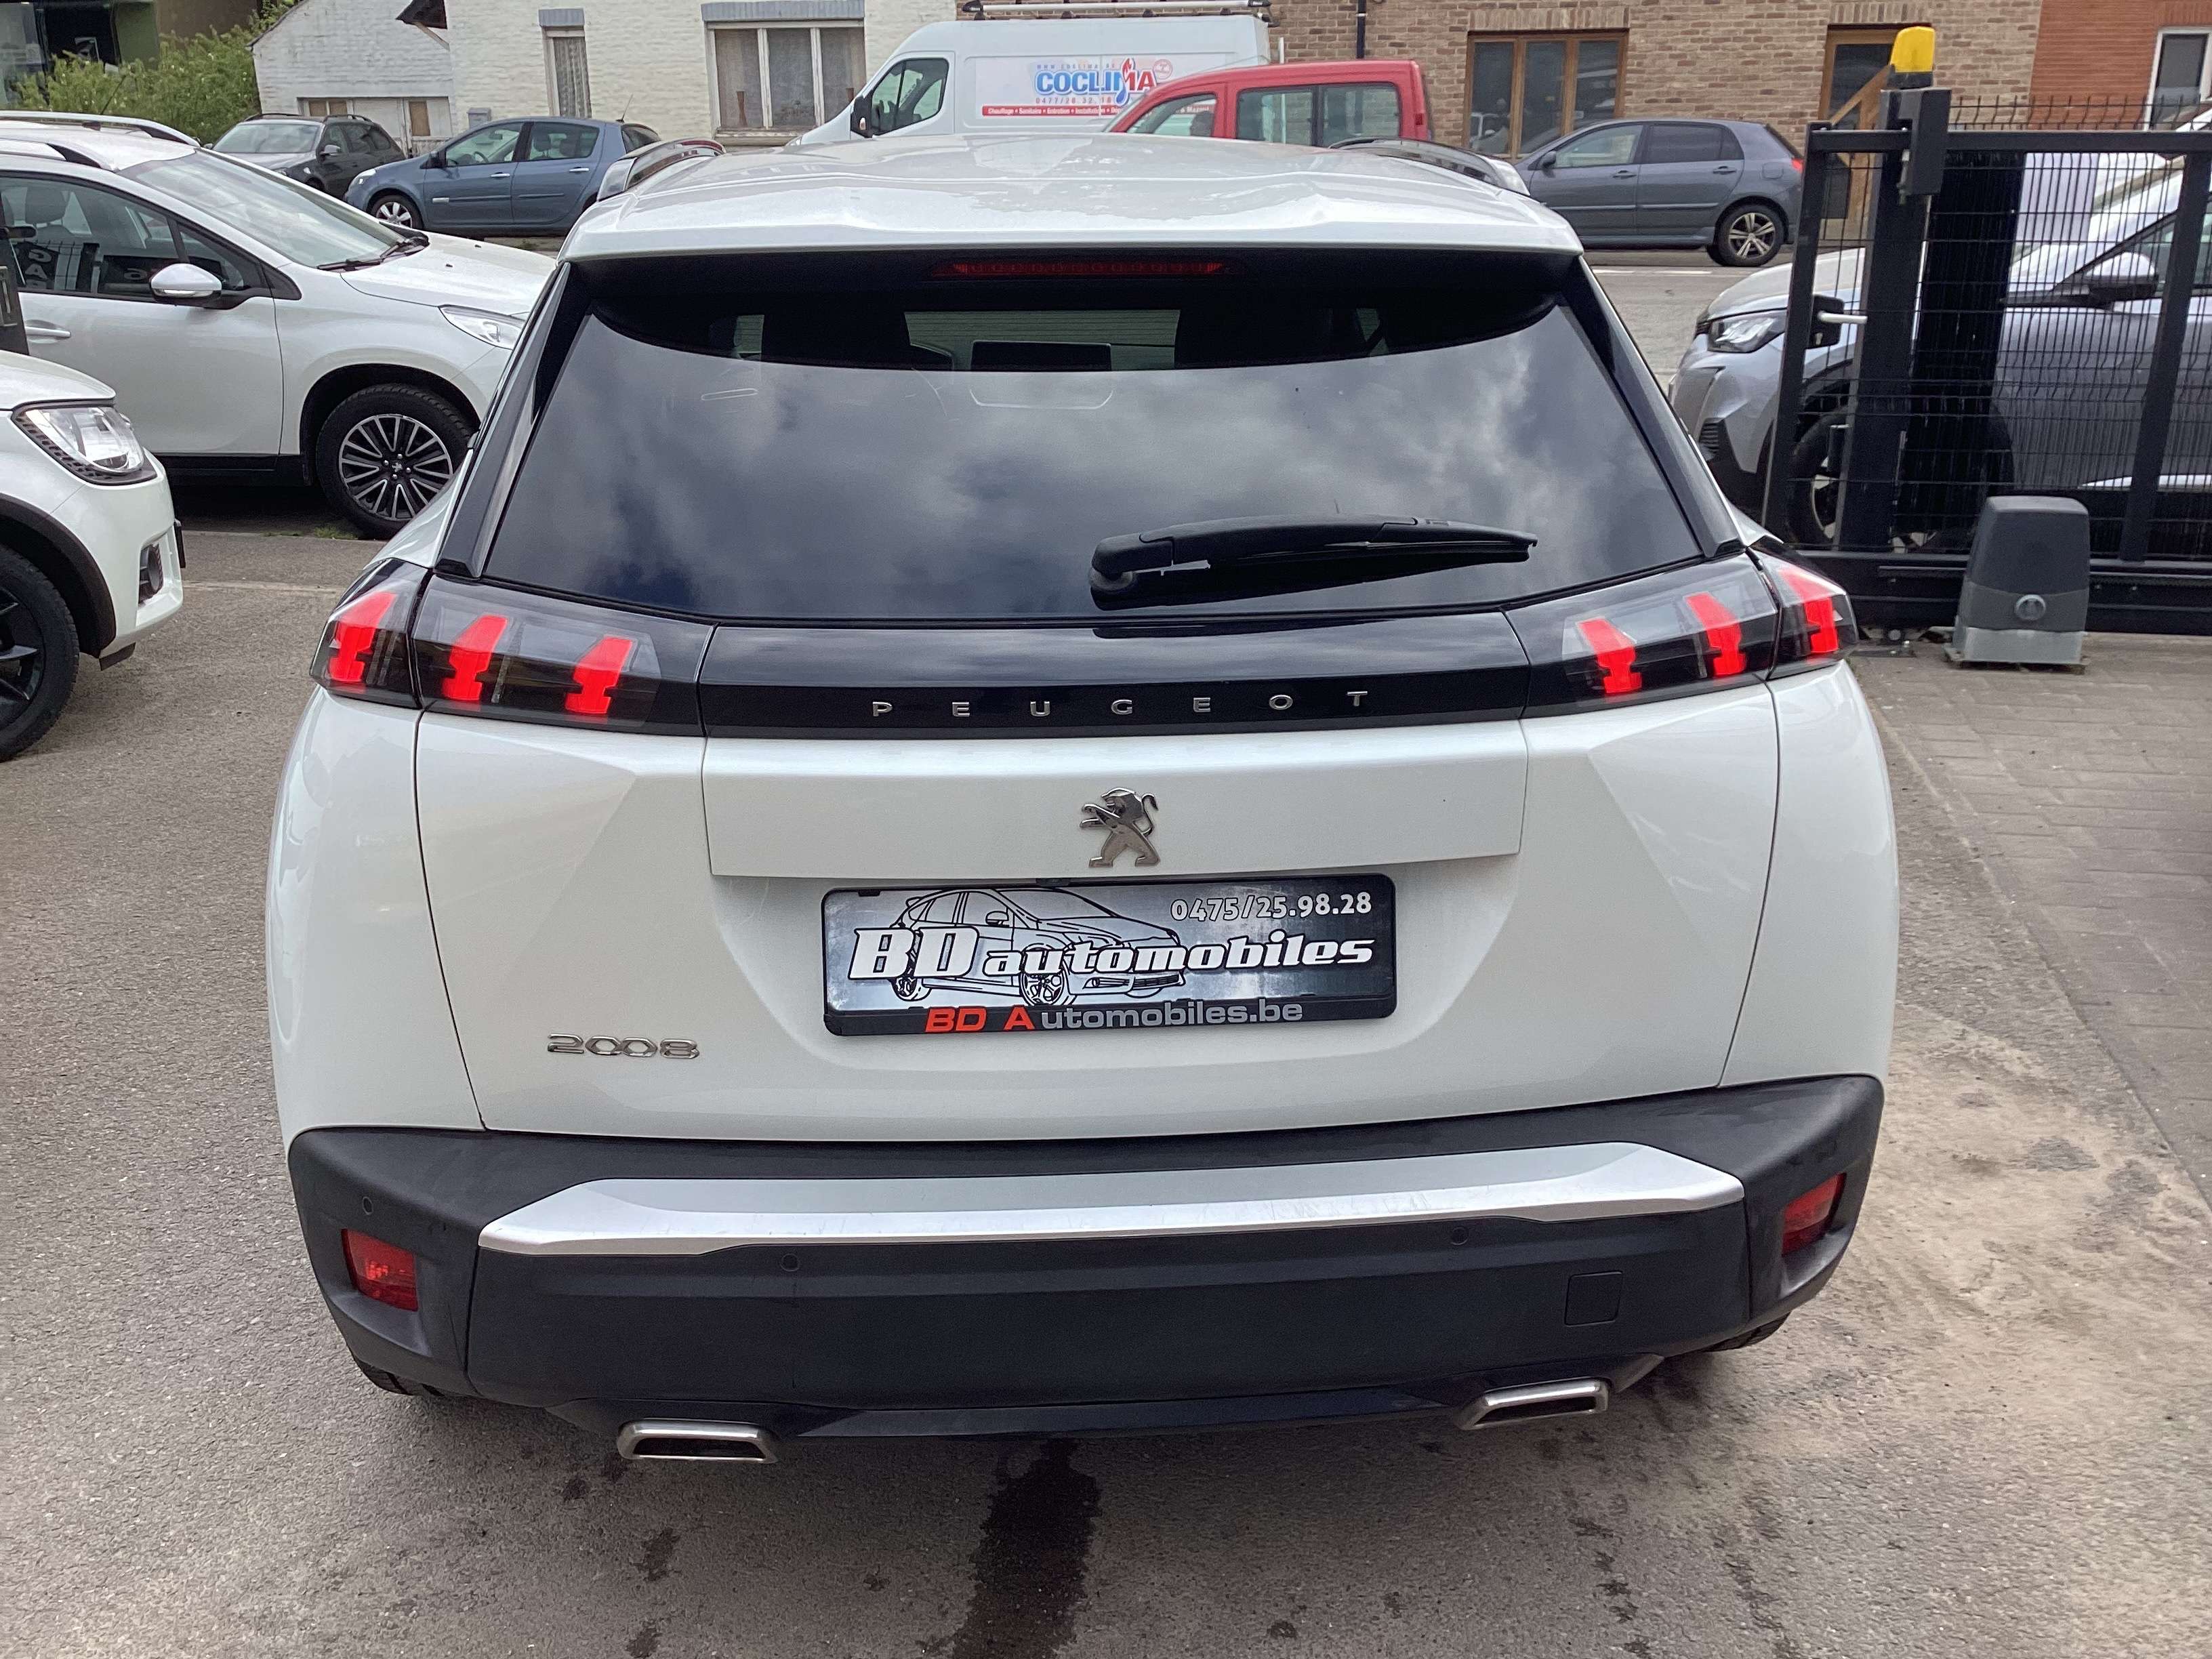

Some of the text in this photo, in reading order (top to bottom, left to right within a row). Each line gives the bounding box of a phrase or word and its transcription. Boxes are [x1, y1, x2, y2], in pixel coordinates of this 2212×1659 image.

[1035, 64, 1156, 100] COCLIMA
[872, 690, 1369, 718] PEUGEOT
[1170, 892, 1372, 923] 0475/25.98.28
[848, 926, 1378, 981] BD automobiles
[924, 1007, 986, 1033] BD
[547, 1033, 700, 1060] 2008
